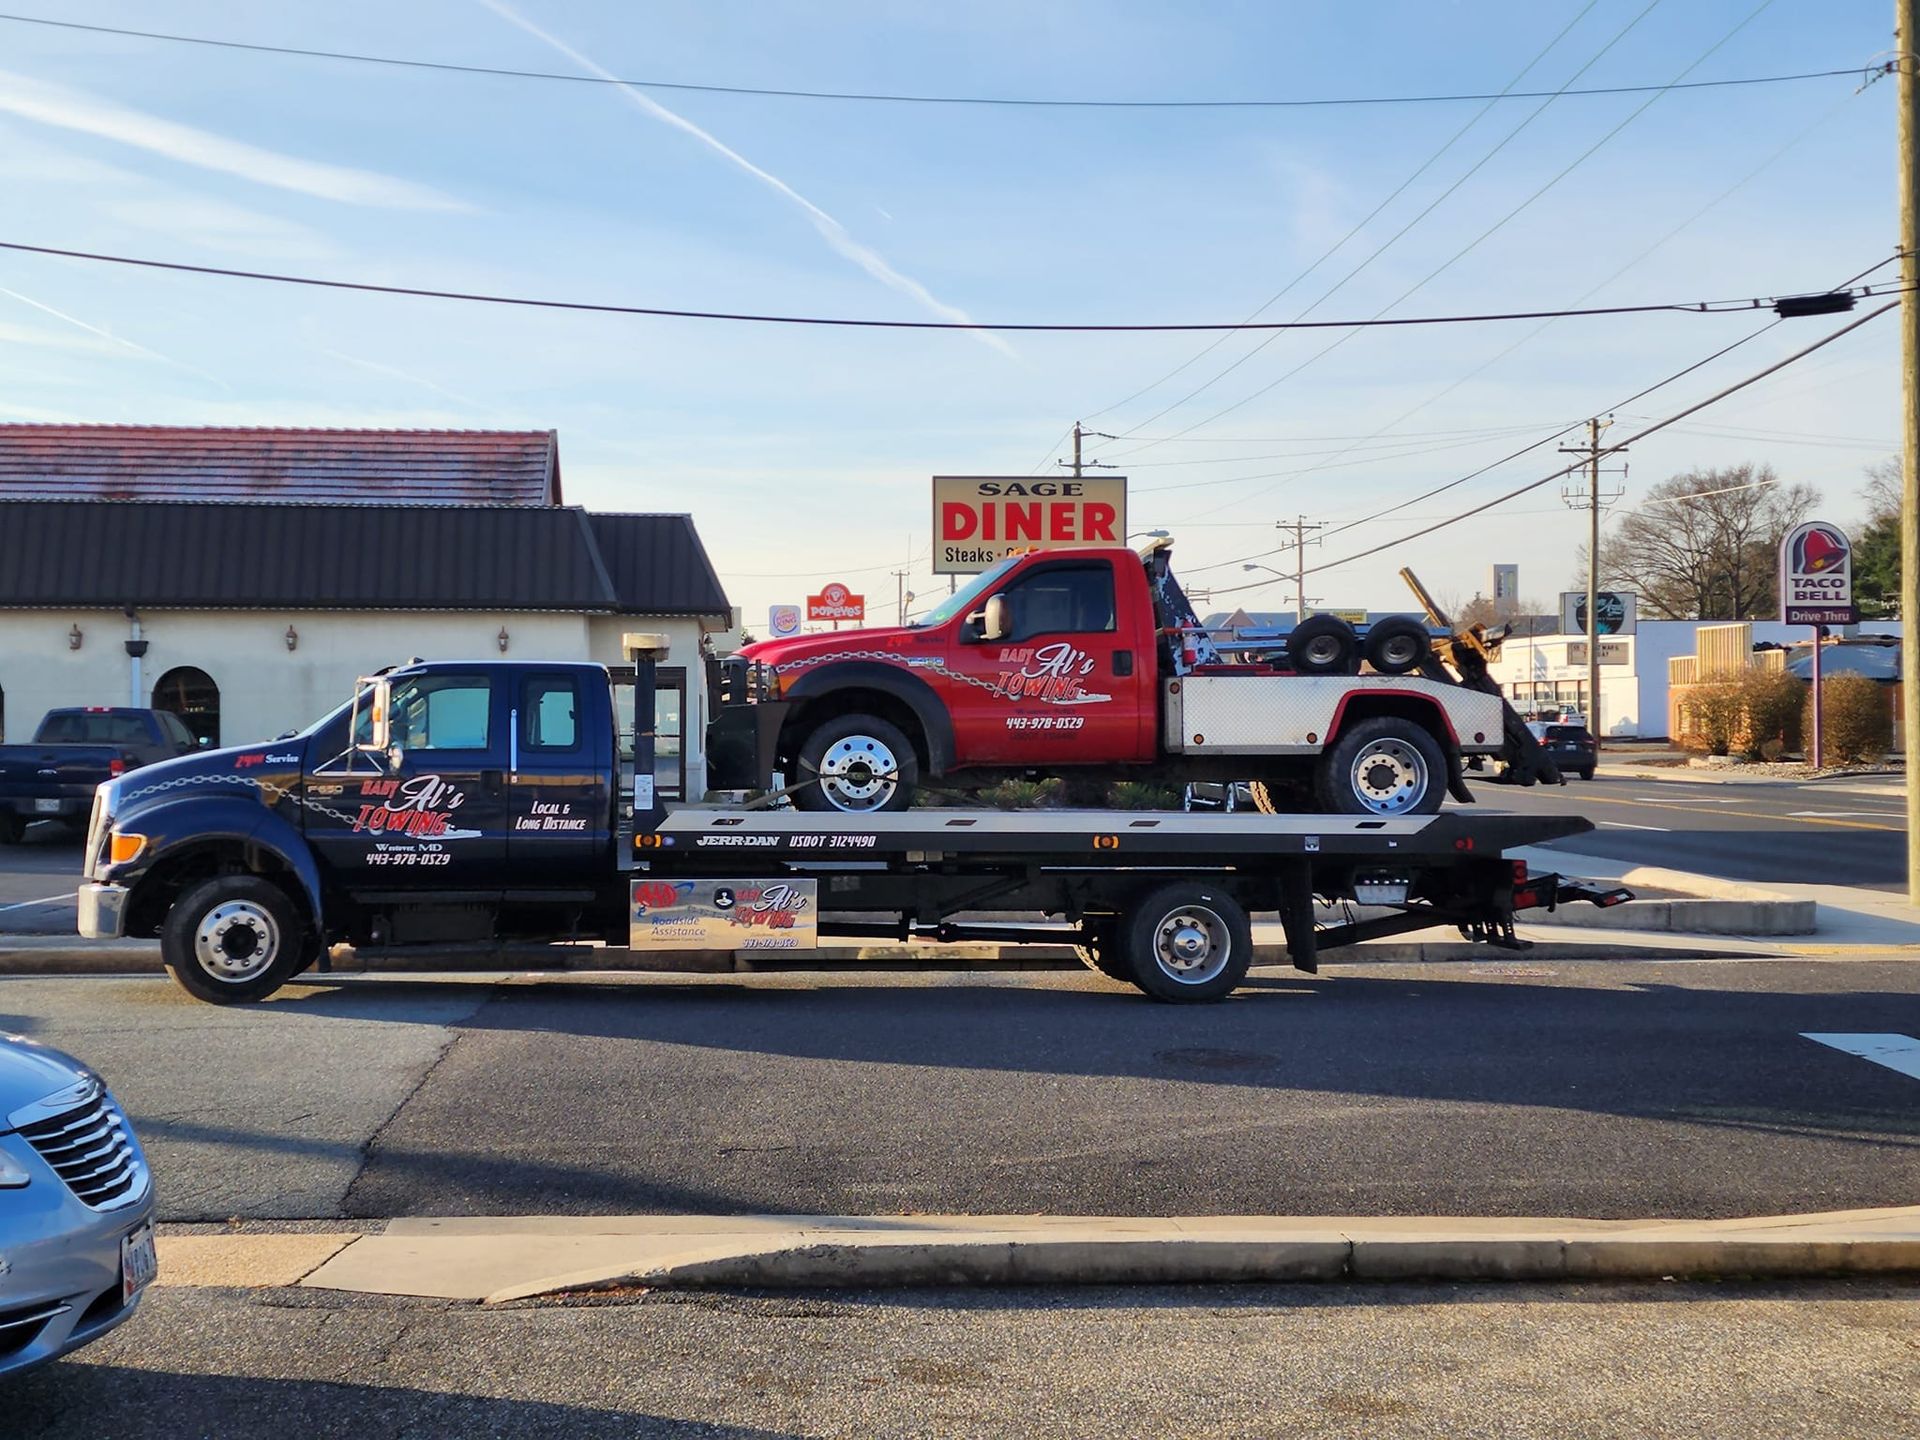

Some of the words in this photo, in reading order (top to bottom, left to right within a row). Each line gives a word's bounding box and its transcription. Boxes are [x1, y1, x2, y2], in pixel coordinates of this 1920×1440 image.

[977, 482, 1083, 496] SAGE
[942, 502, 1117, 541] DINER
[945, 547, 993, 563] Steaks
[1791, 578, 1846, 588] TACO
[1794, 591, 1847, 600] BELL
[1791, 611, 1821, 621] Drive
[1822, 611, 1850, 621] Thru
[1020, 643, 1095, 678] Al's
[993, 671, 1085, 700] TOWING
[1006, 717, 1085, 729] 443-978-0529
[265, 753, 299, 764] Service
[384, 774, 464, 812] Al's
[562, 803, 571, 814] &
[352, 804, 453, 838] TOWING
[418, 843, 443, 851] MD
[789, 835, 827, 847] USDOT
[829, 835, 877, 847] 3124490
[366, 853, 451, 865] 443-978-0529
[751, 884, 807, 911] Al's
[651, 916, 700, 926] Roadside
[651, 926, 706, 937] Assistance
